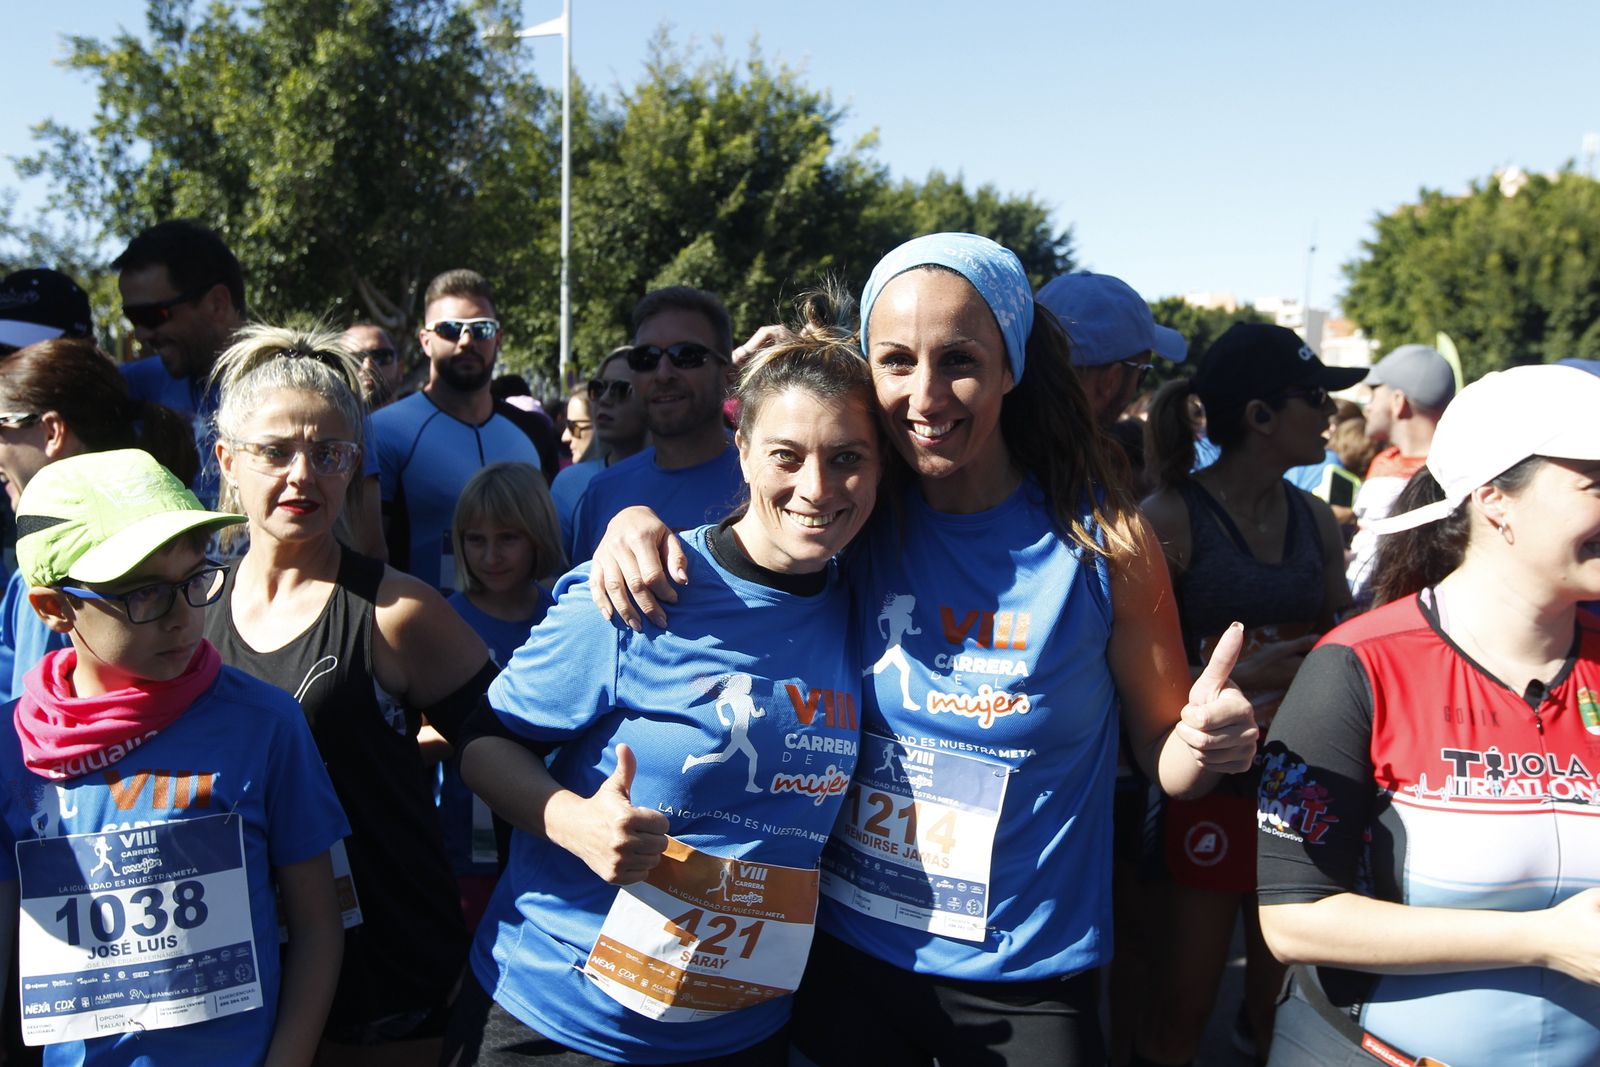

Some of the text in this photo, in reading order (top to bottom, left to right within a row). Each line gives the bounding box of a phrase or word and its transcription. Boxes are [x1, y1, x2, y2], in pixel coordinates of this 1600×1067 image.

[939, 606, 1032, 650] VIII
[934, 653, 1030, 677] CARRERA
[784, 684, 858, 731] VIII
[784, 733, 857, 757] CARRERA
[920, 737, 1037, 759] ES NUESTRA META
[103, 768, 215, 811] VIII
[658, 802, 674, 816] LA
[744, 817, 760, 831] ES
[762, 823, 808, 839] NUESTRA
[847, 781, 959, 855] 1214
[119, 829, 158, 849] VIII
[844, 823, 899, 856] RENDIRSE
[902, 846, 950, 870] JAMAS
[1271, 828, 1304, 843] Deportivo
[120, 846, 160, 858] CARRERA
[114, 877, 126, 888] ES
[128, 873, 171, 887] NUESTRA
[173, 866, 199, 879] META
[734, 879, 765, 891] CARRERA
[739, 864, 769, 882] VIII
[56, 880, 209, 946] 1038
[664, 907, 766, 960] 421
[88, 935, 178, 960] JOSÉ LUIS
[681, 950, 730, 970] SARAY
[24, 1001, 51, 1015] NEXA
[54, 997, 77, 1010] CDX
